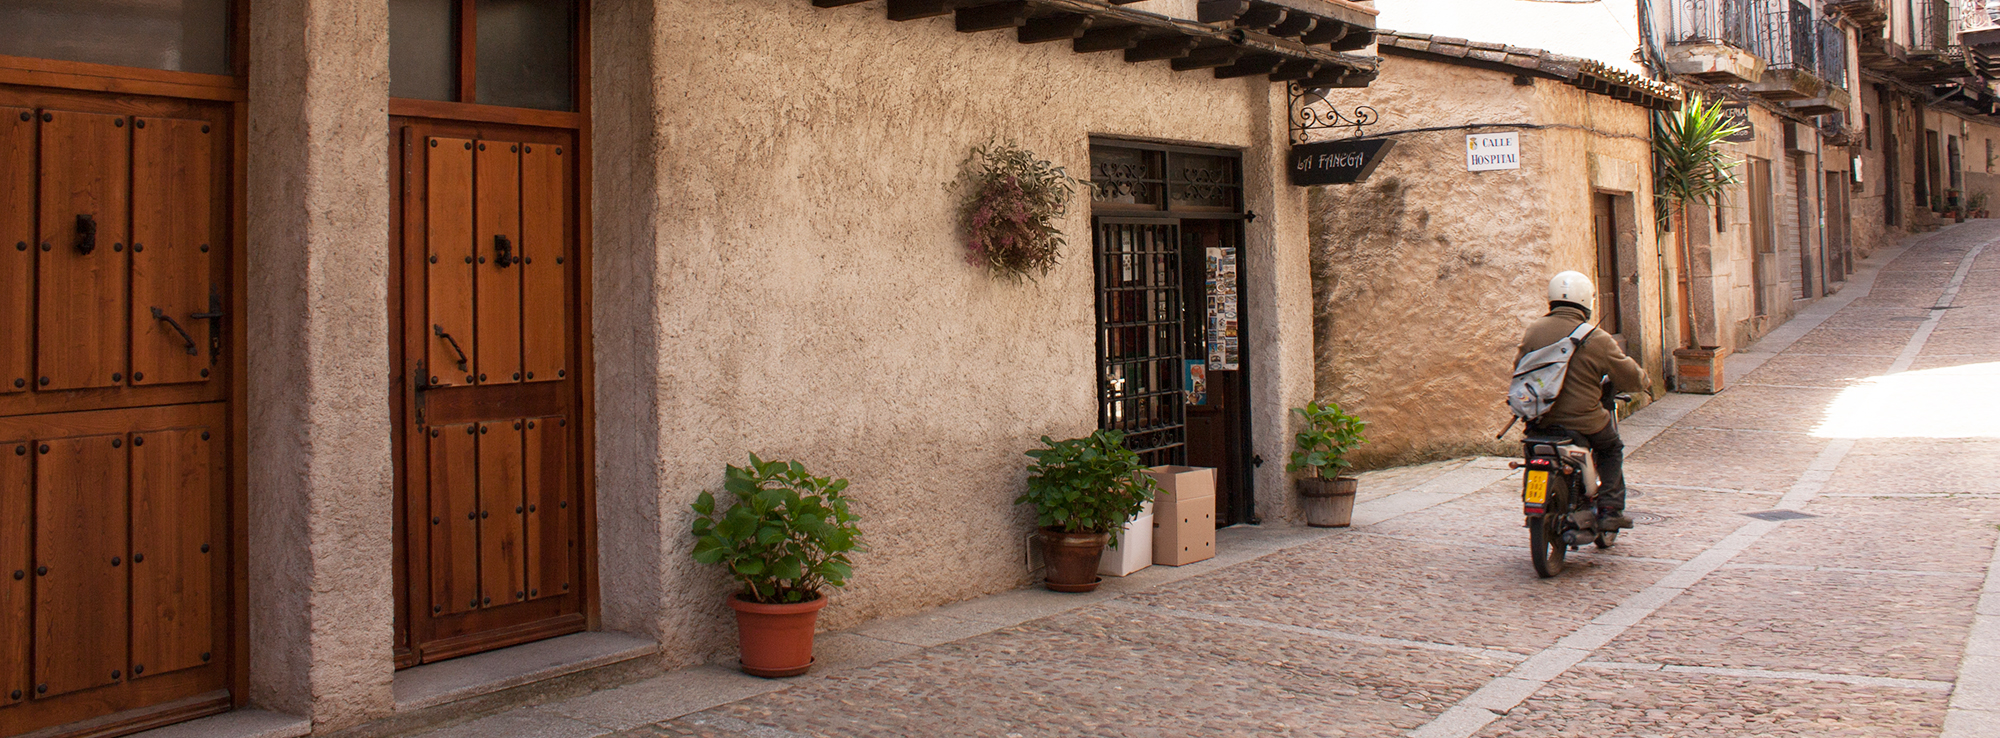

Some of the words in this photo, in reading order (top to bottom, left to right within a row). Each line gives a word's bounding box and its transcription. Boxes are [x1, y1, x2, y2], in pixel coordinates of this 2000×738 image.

[1482, 137, 1513, 148] CALLE
[1297, 155, 1313, 172] LA
[1318, 152, 1364, 170] FANEGA
[1471, 153, 1518, 165] HOSPITAL
